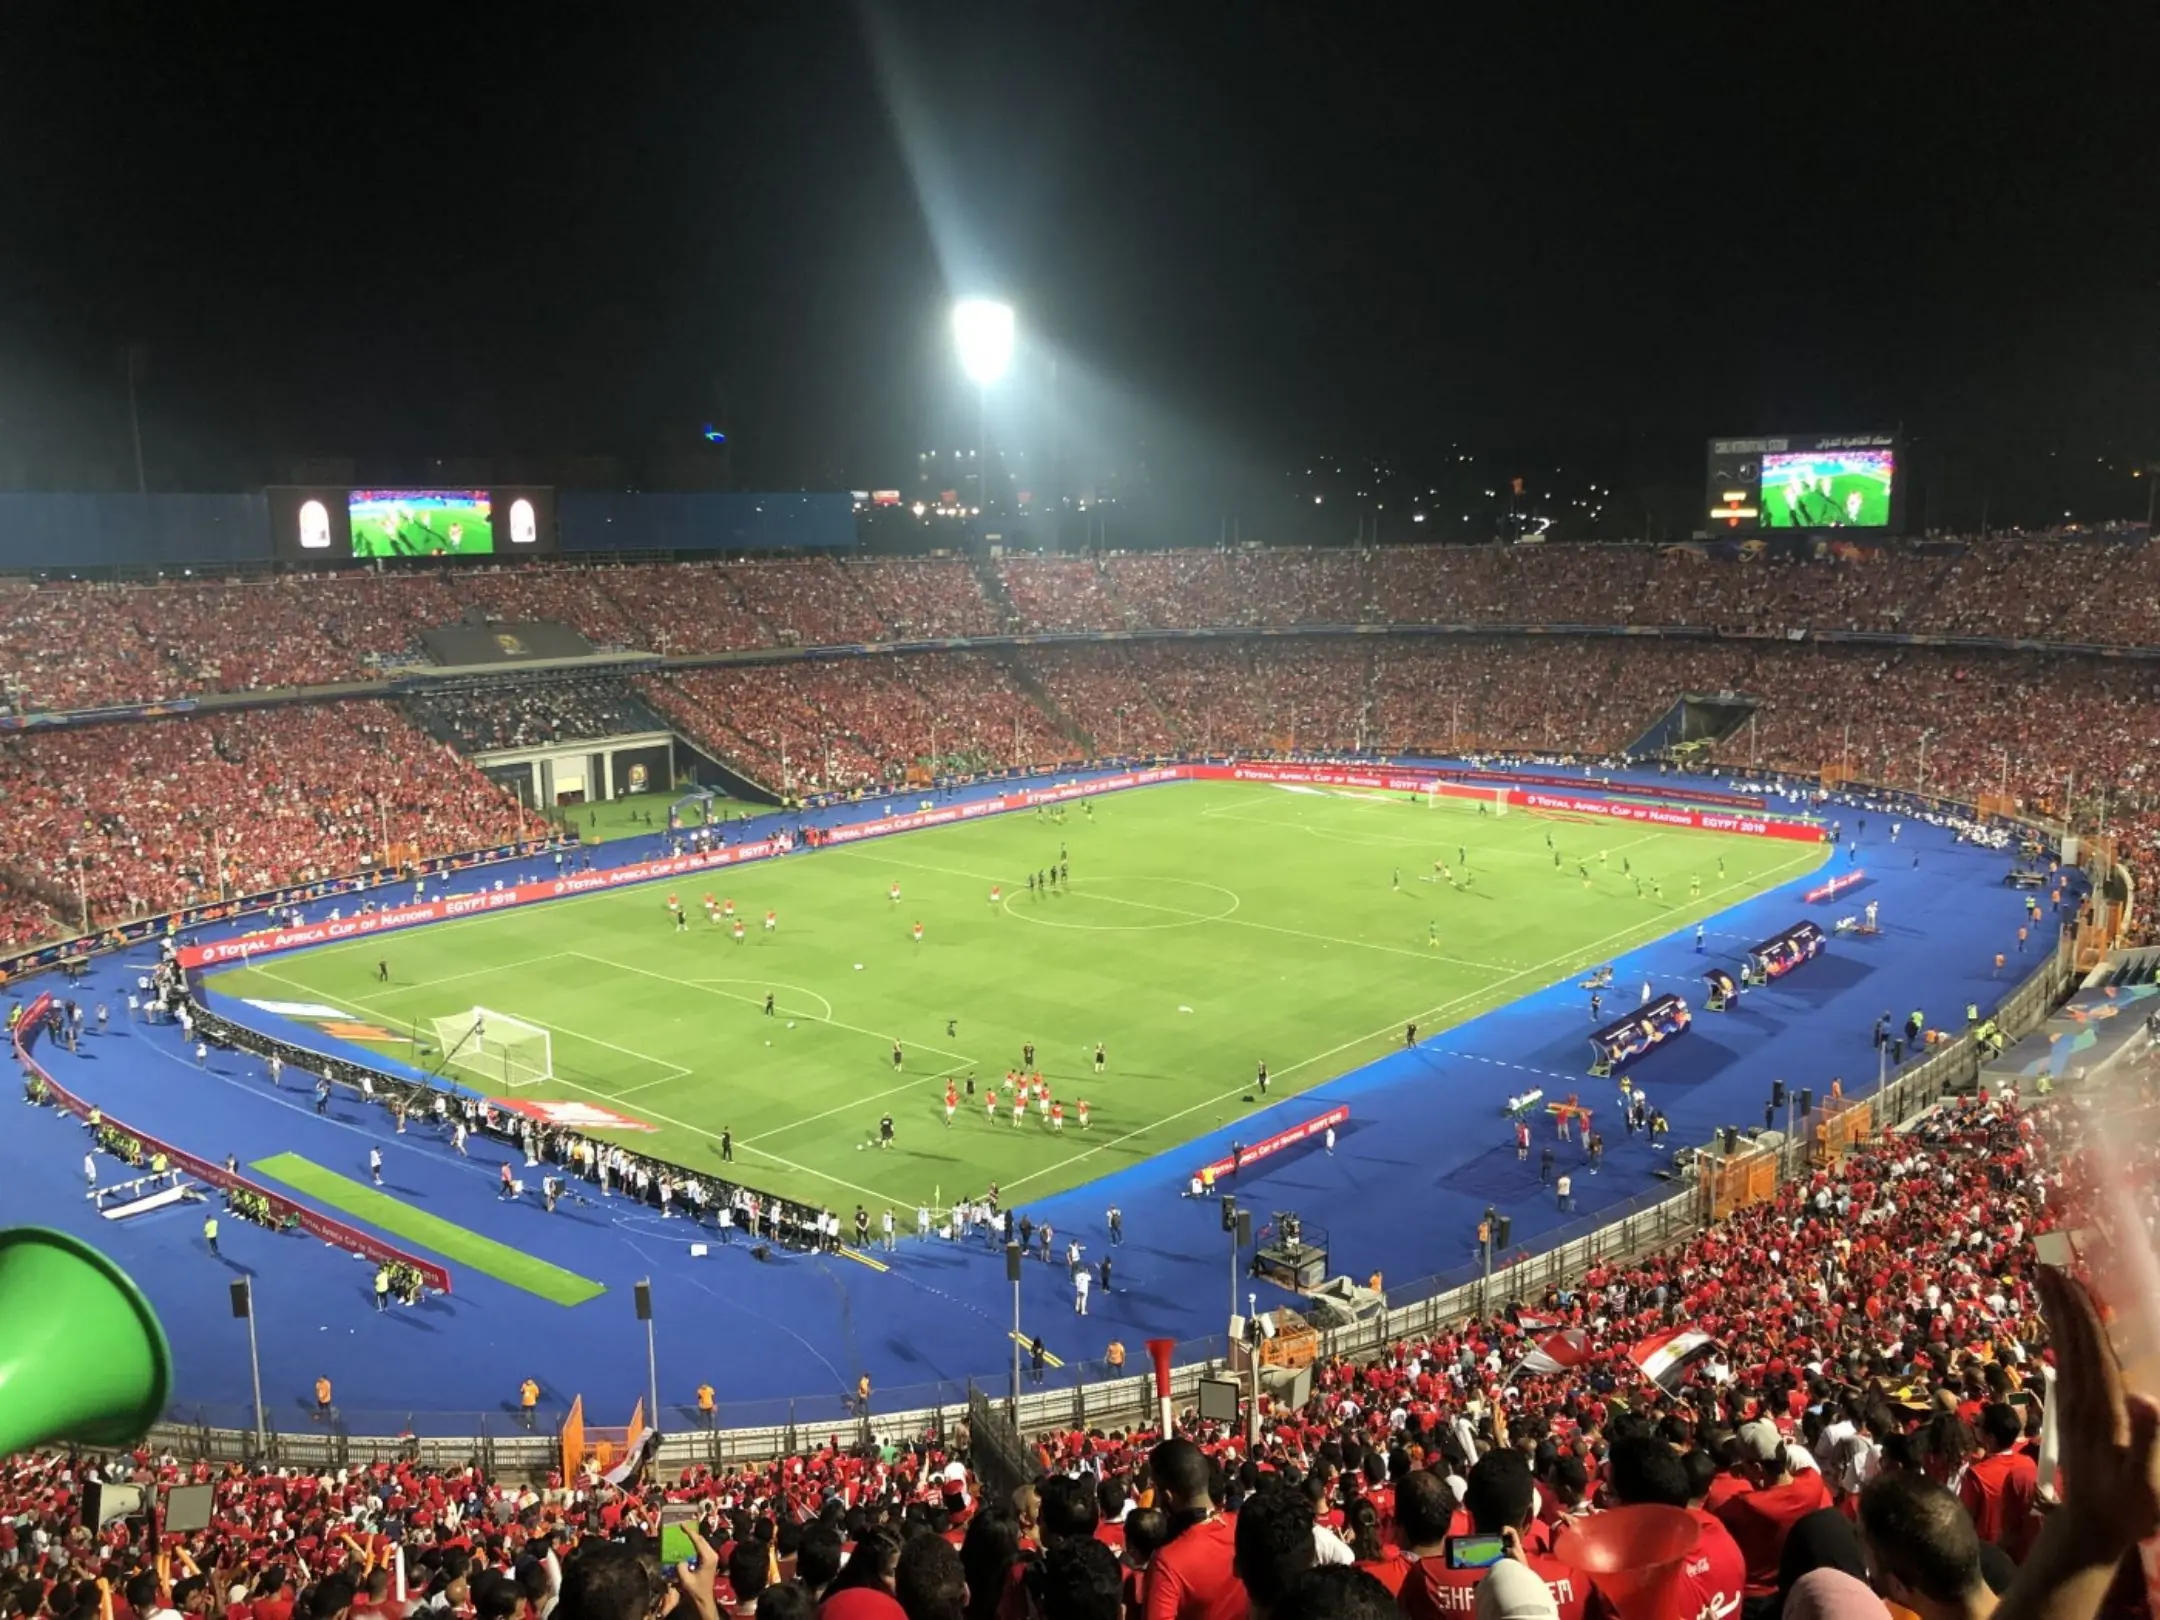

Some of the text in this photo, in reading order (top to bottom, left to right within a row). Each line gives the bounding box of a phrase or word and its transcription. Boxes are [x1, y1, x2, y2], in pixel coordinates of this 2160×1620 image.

[1245, 770, 1275, 779] TOTAL
[1279, 772, 1311, 781] AFRICA
[1313, 772, 1331, 782] CUP
[1347, 775, 1382, 786] NATIONS
[1389, 780, 1418, 790] EGYPT
[894, 819, 912, 829] CUP
[1538, 797, 1766, 833] TOTAL AFRICA CUP OF NATIONS EGYPT 2019
[567, 876, 606, 890] TOTAL
[610, 869, 648, 882] AFRICA
[651, 863, 673, 875] CUP
[674, 862, 687, 870] OF
[739, 843, 770, 858] EGYPT
[218, 891, 517, 957] TOTAL AFRICA CUP OF NATIONS EGYPT 2019
